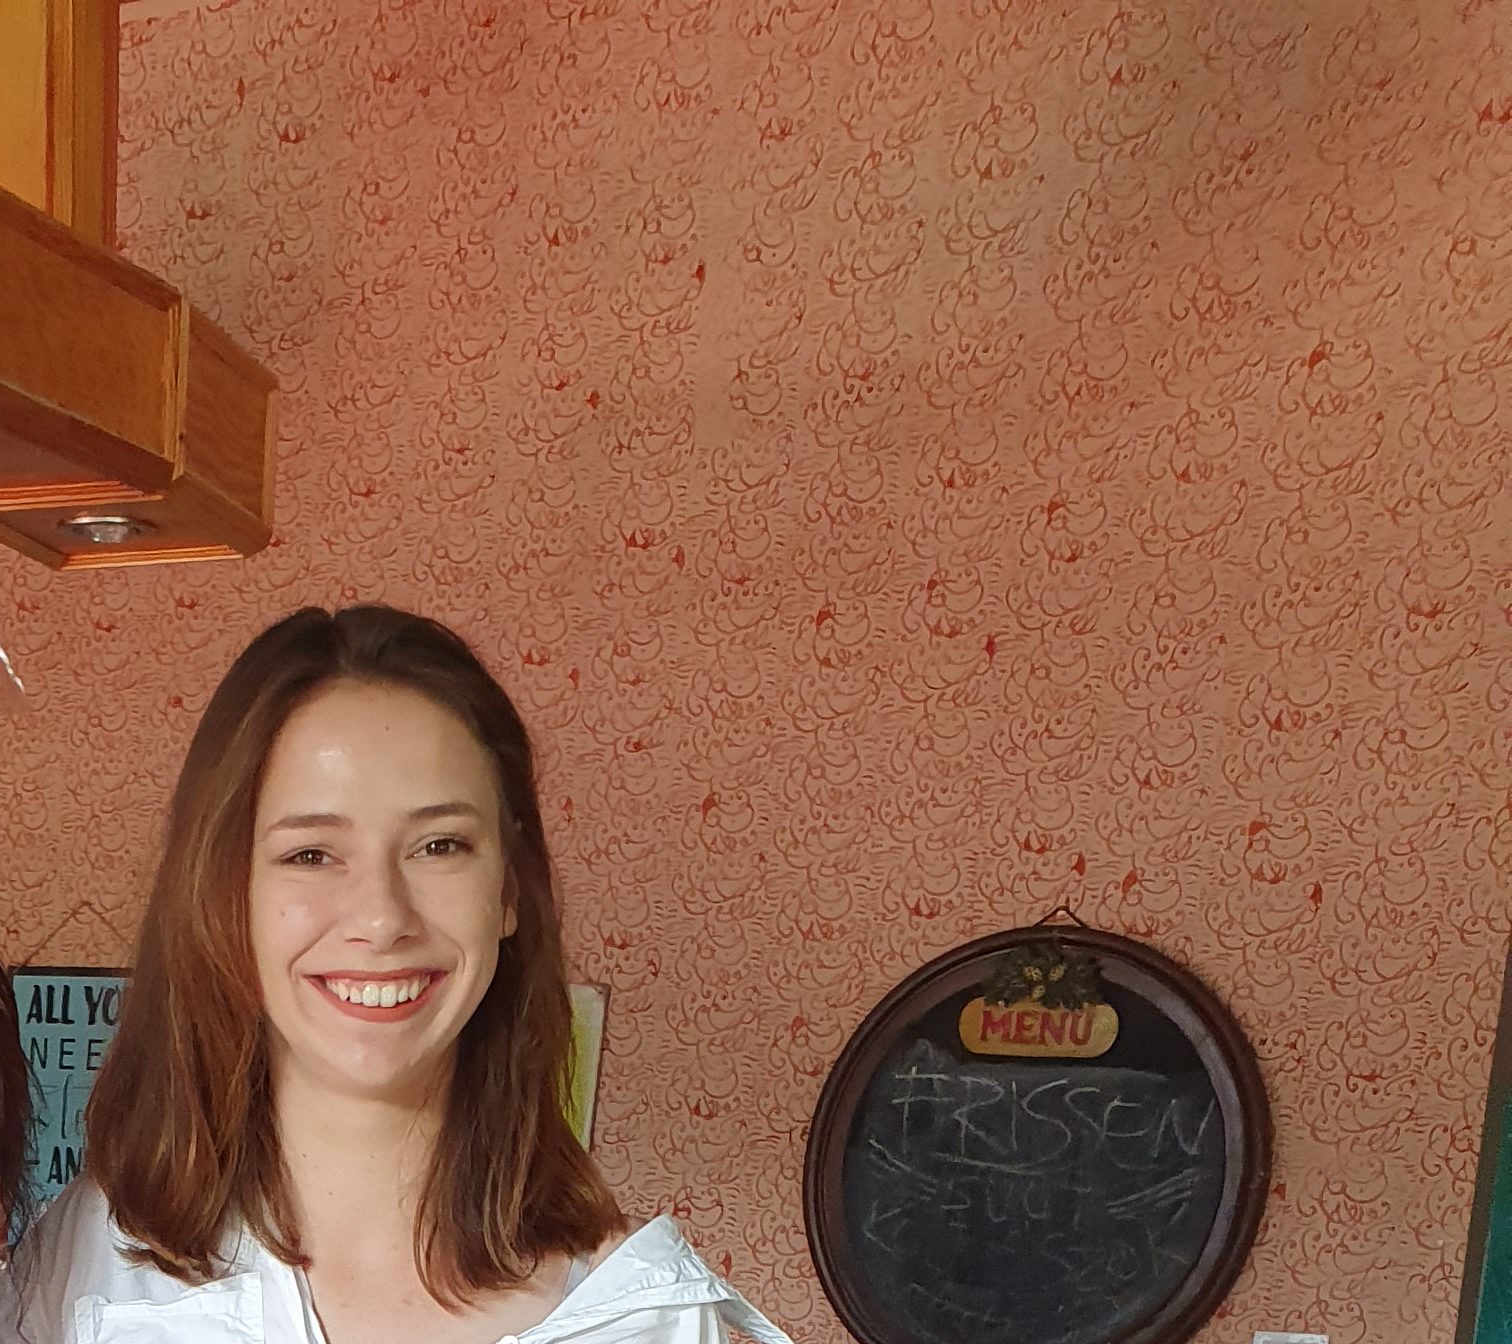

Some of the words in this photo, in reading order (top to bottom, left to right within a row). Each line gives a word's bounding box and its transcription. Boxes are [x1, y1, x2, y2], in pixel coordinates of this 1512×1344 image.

[26, 984, 76, 1025] ALL
[84, 985, 121, 1027] YO
[979, 1009, 1094, 1047] MENU
[29, 1036, 105, 1071] NEE
[46, 1146, 83, 1185] AN
